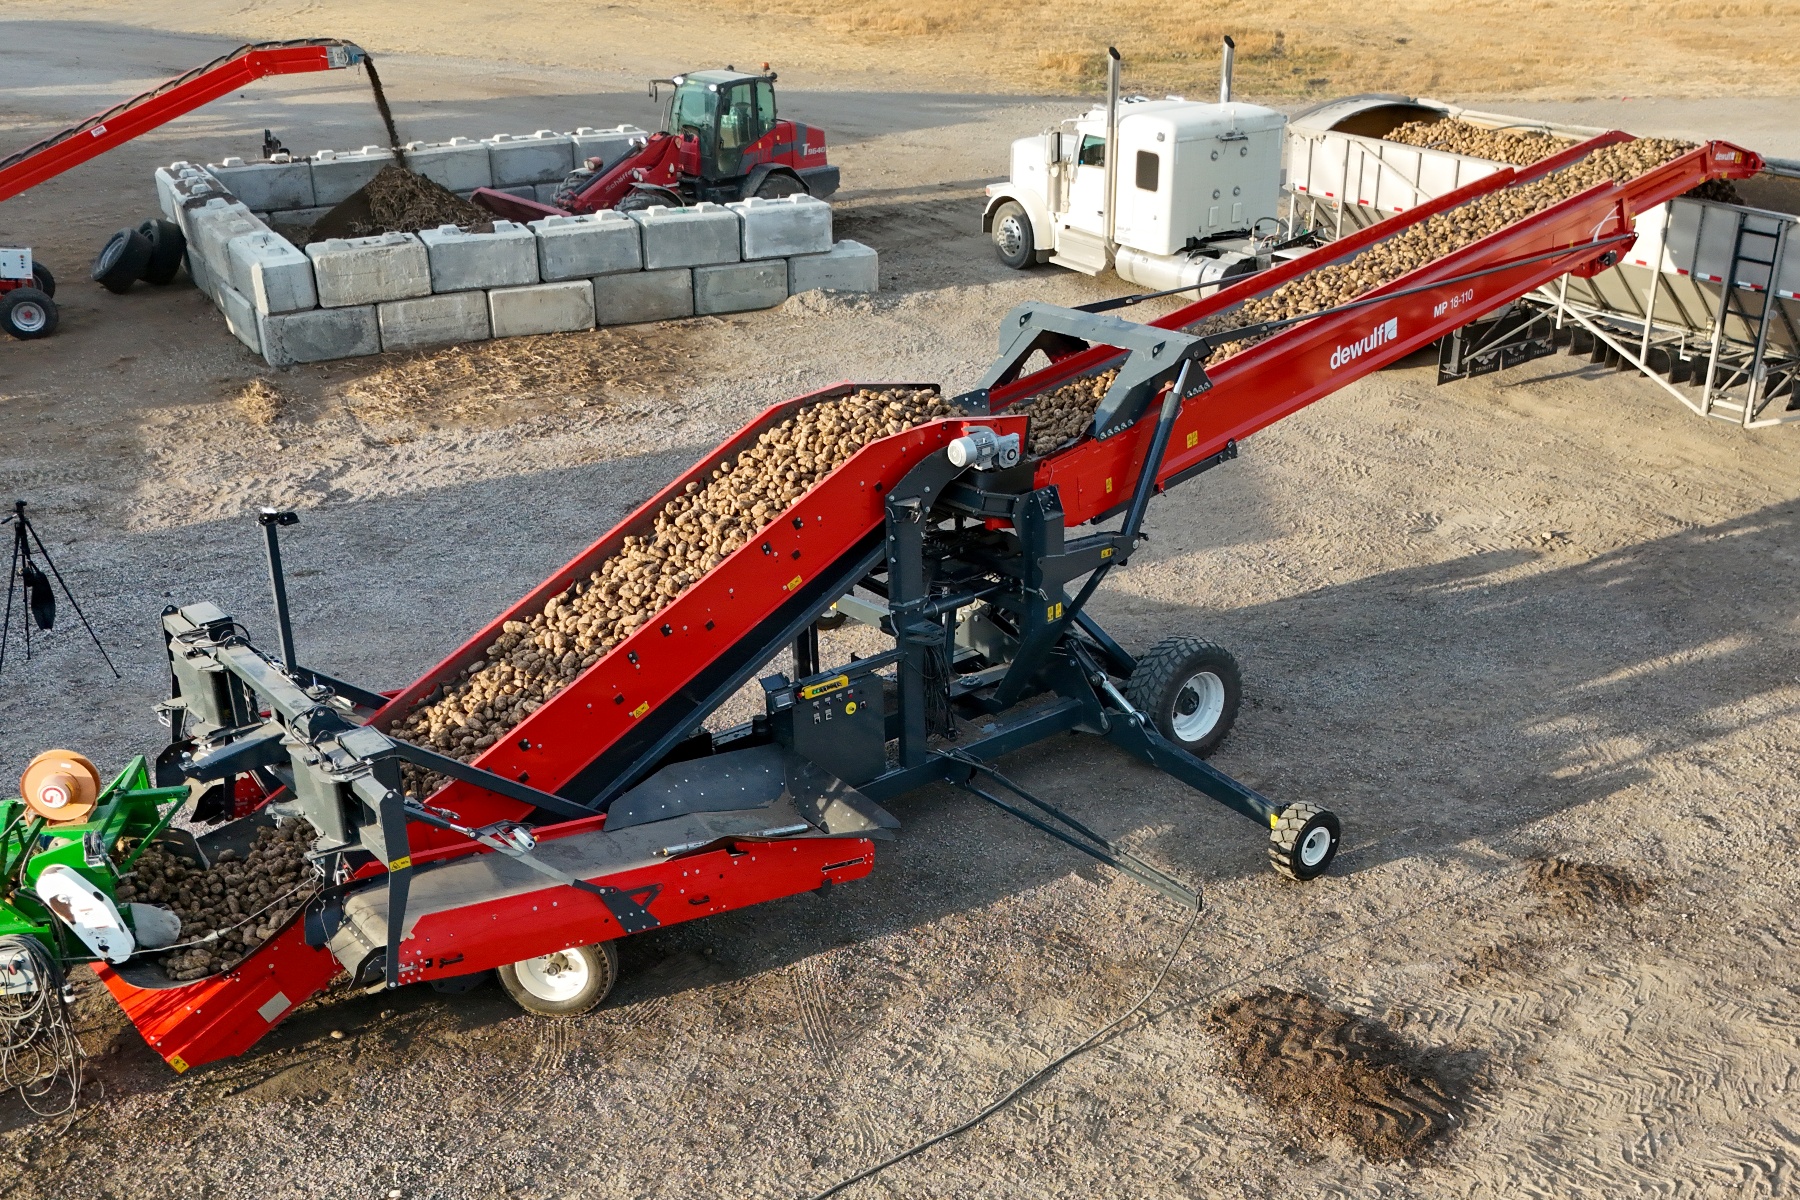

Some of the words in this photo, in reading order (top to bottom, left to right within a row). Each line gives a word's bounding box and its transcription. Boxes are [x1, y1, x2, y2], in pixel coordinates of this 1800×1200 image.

[1434, 301, 1448, 318] MP
[1450, 288, 1474, 310] 18-110
[1330, 323, 1384, 370] dewulf
